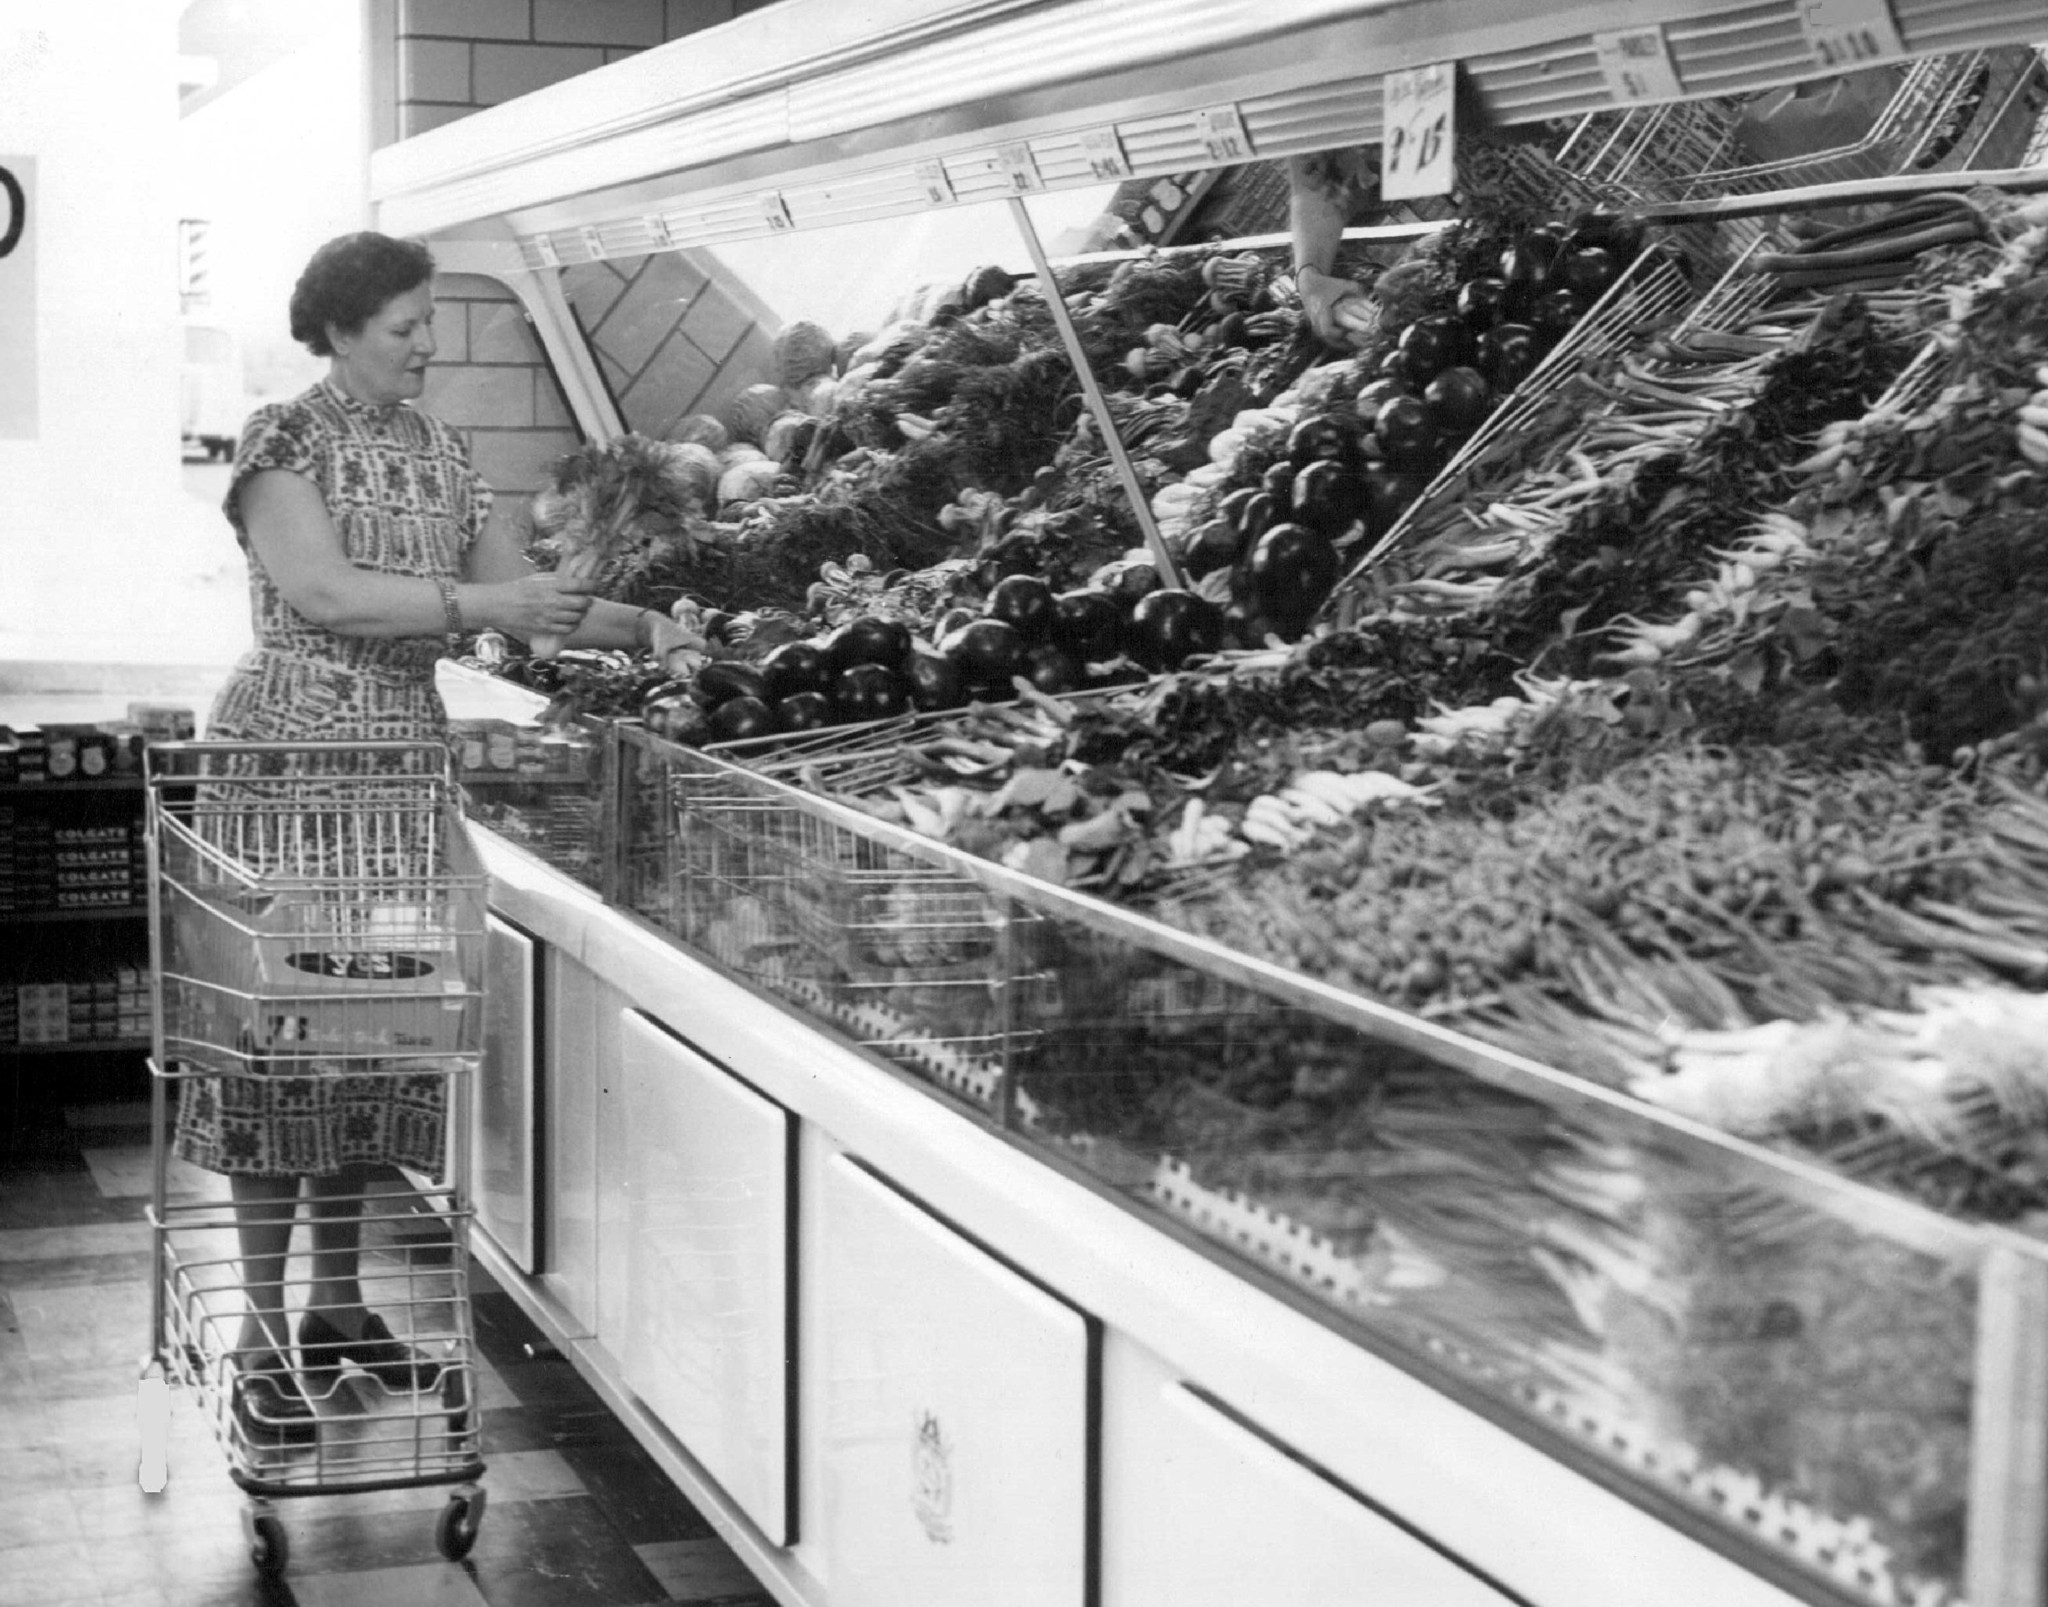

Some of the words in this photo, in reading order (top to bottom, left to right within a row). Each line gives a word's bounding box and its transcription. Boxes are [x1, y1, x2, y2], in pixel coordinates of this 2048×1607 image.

[54, 827, 127, 840] COLGATE
[56, 850, 129, 861] COLGATE
[58, 870, 129, 882] COLGATE
[58, 890, 129, 902] COLGATE
